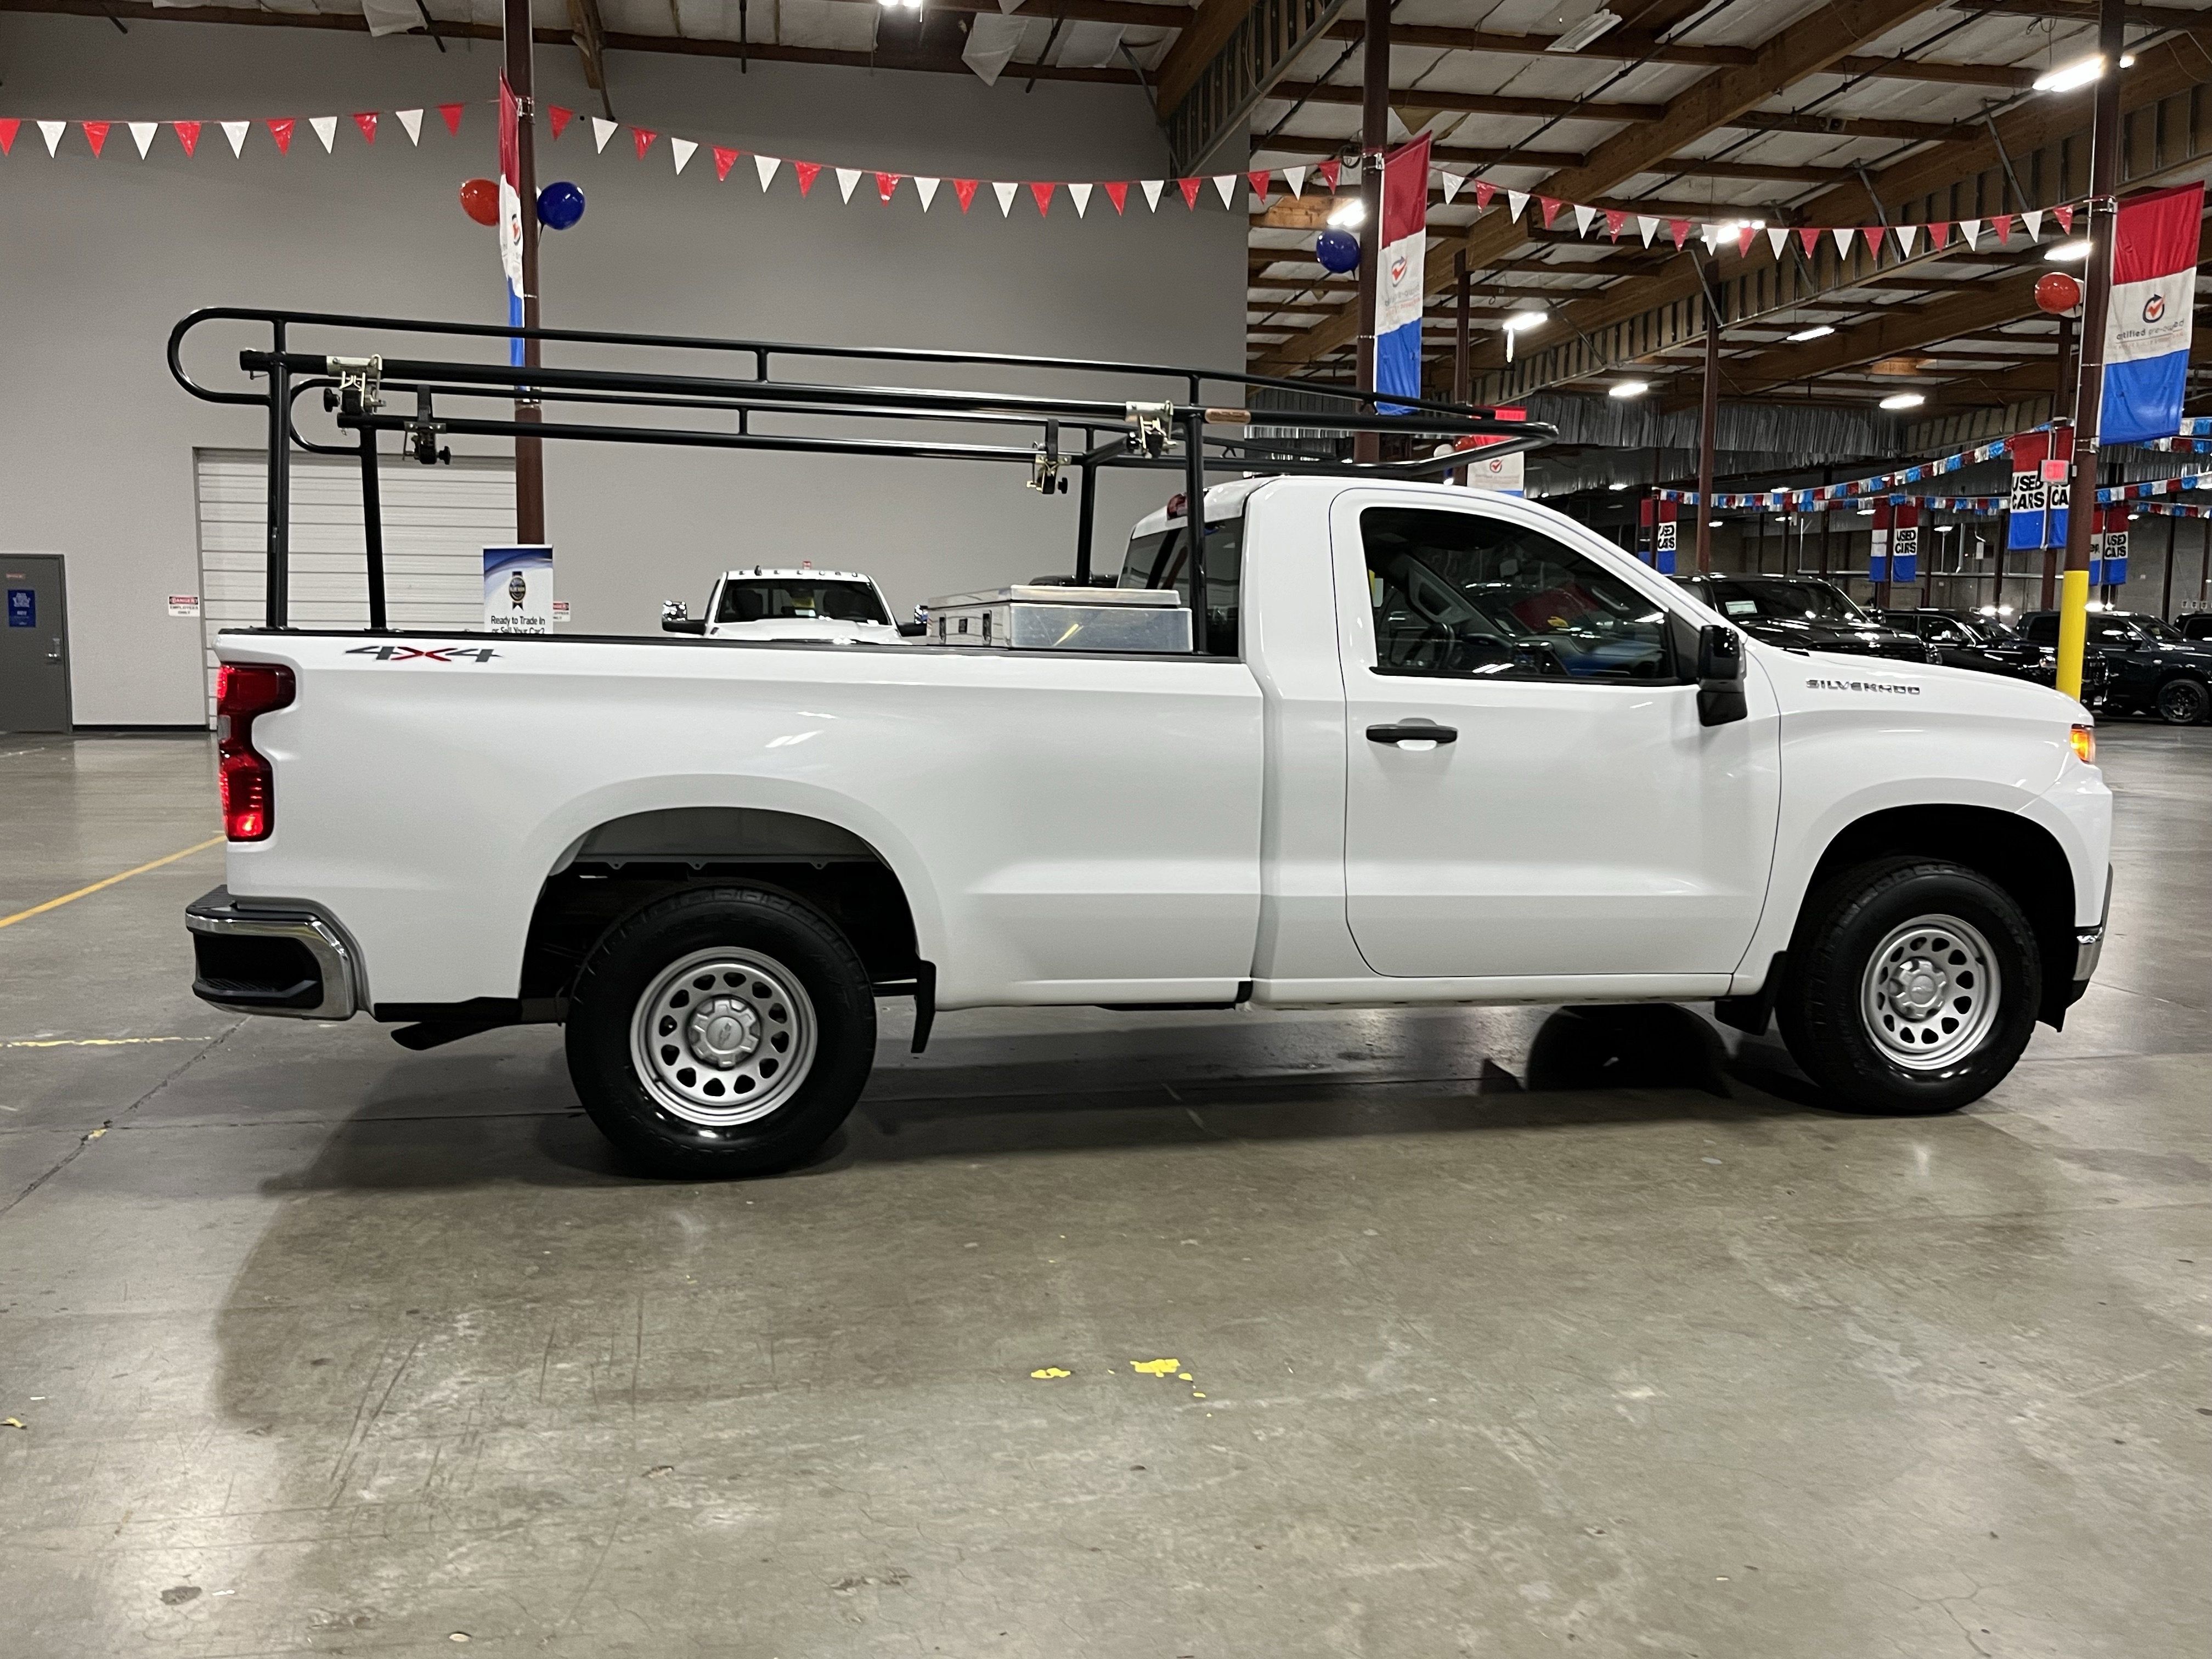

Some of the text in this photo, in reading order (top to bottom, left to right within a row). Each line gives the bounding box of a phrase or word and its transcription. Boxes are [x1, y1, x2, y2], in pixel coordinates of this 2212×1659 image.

[2012, 492, 2045, 509] CARS
[2052, 489, 2069, 505] CA
[1658, 525, 1674, 537] UED
[1897, 530, 1916, 541] USED
[491, 615, 510, 627] Ready
[520, 616, 538, 625] Trade
[539, 616, 546, 625] In
[1805, 679, 1920, 695] SILVERADO
